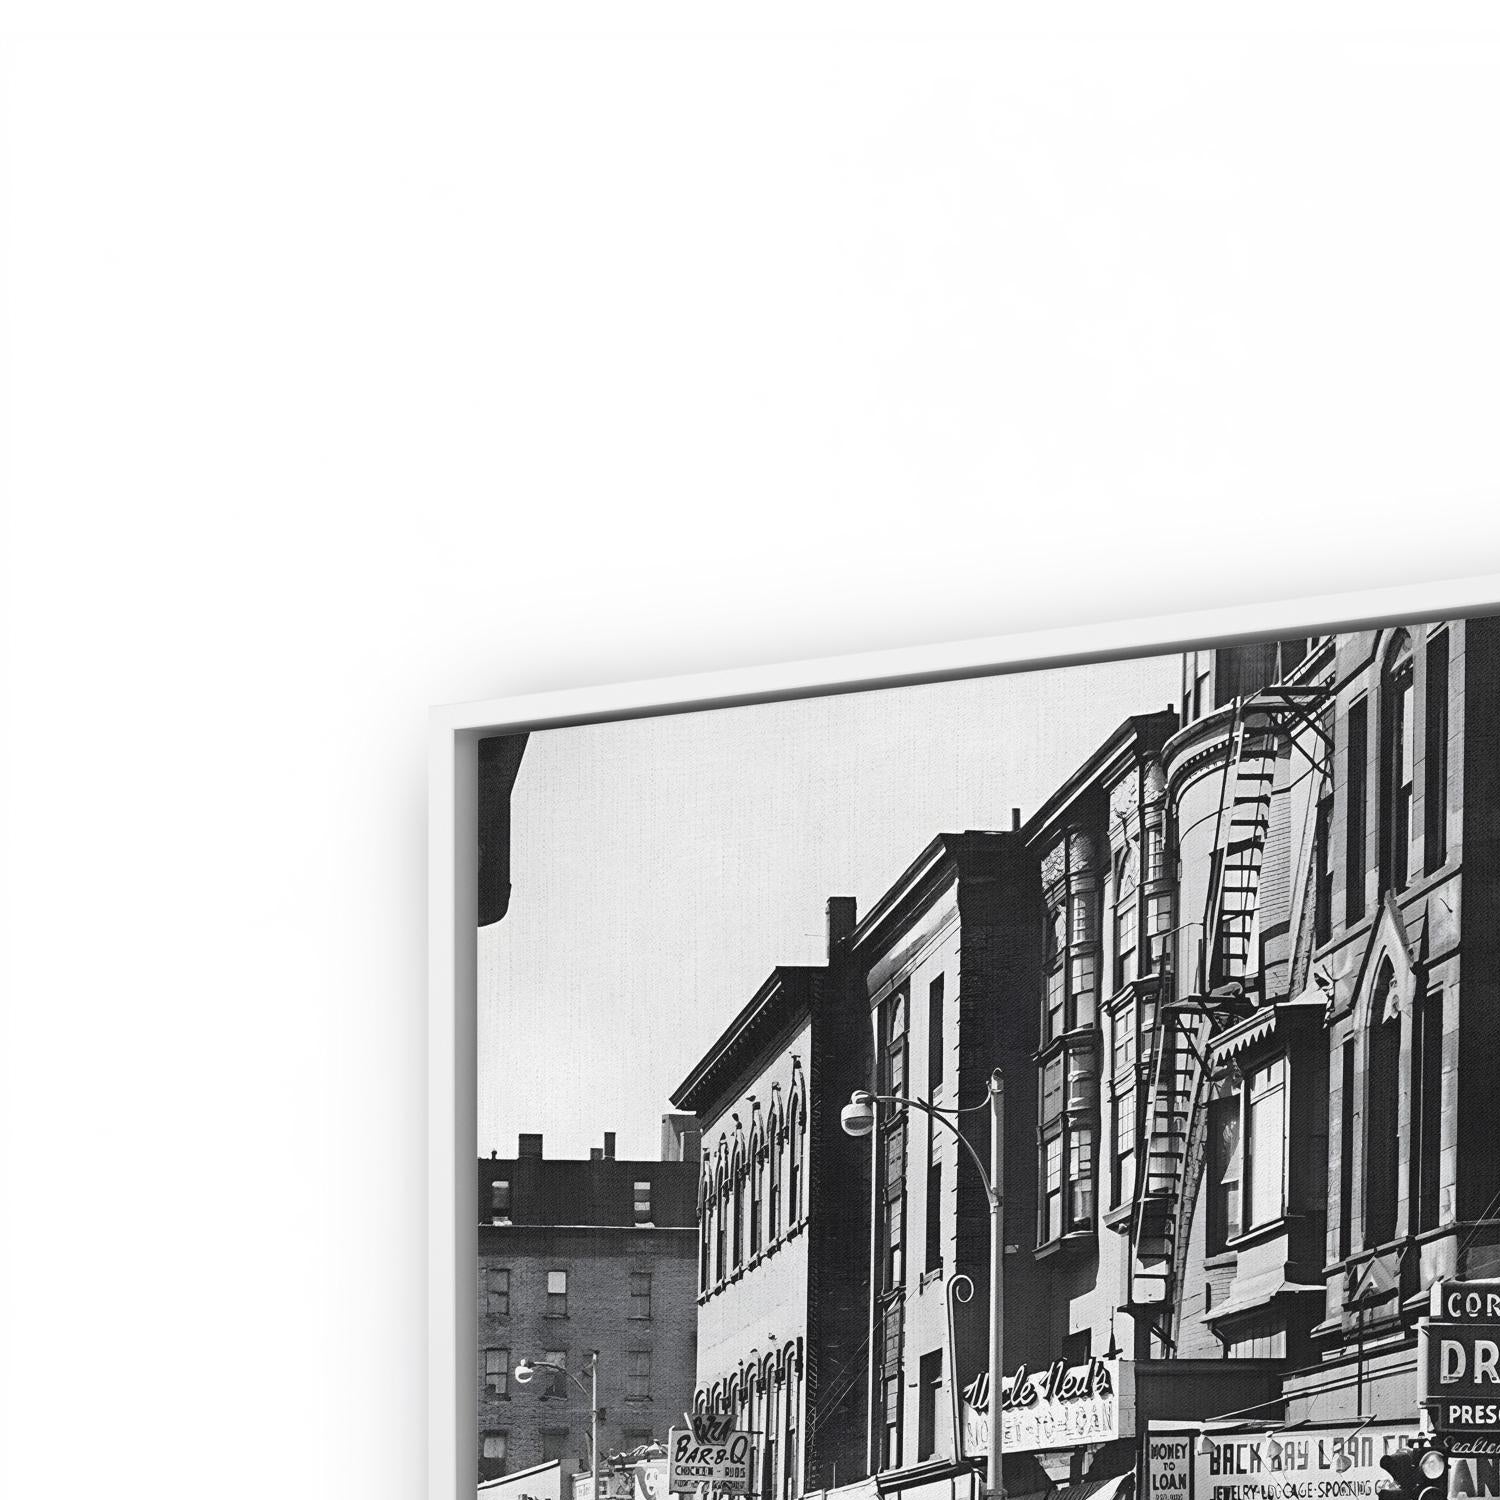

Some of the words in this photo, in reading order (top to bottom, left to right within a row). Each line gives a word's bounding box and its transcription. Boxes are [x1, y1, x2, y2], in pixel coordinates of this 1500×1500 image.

[1150, 1442, 1189, 1460] MONEY
[1163, 1462, 1176, 1472] TO
[1152, 1473, 1187, 1491] LOAN
